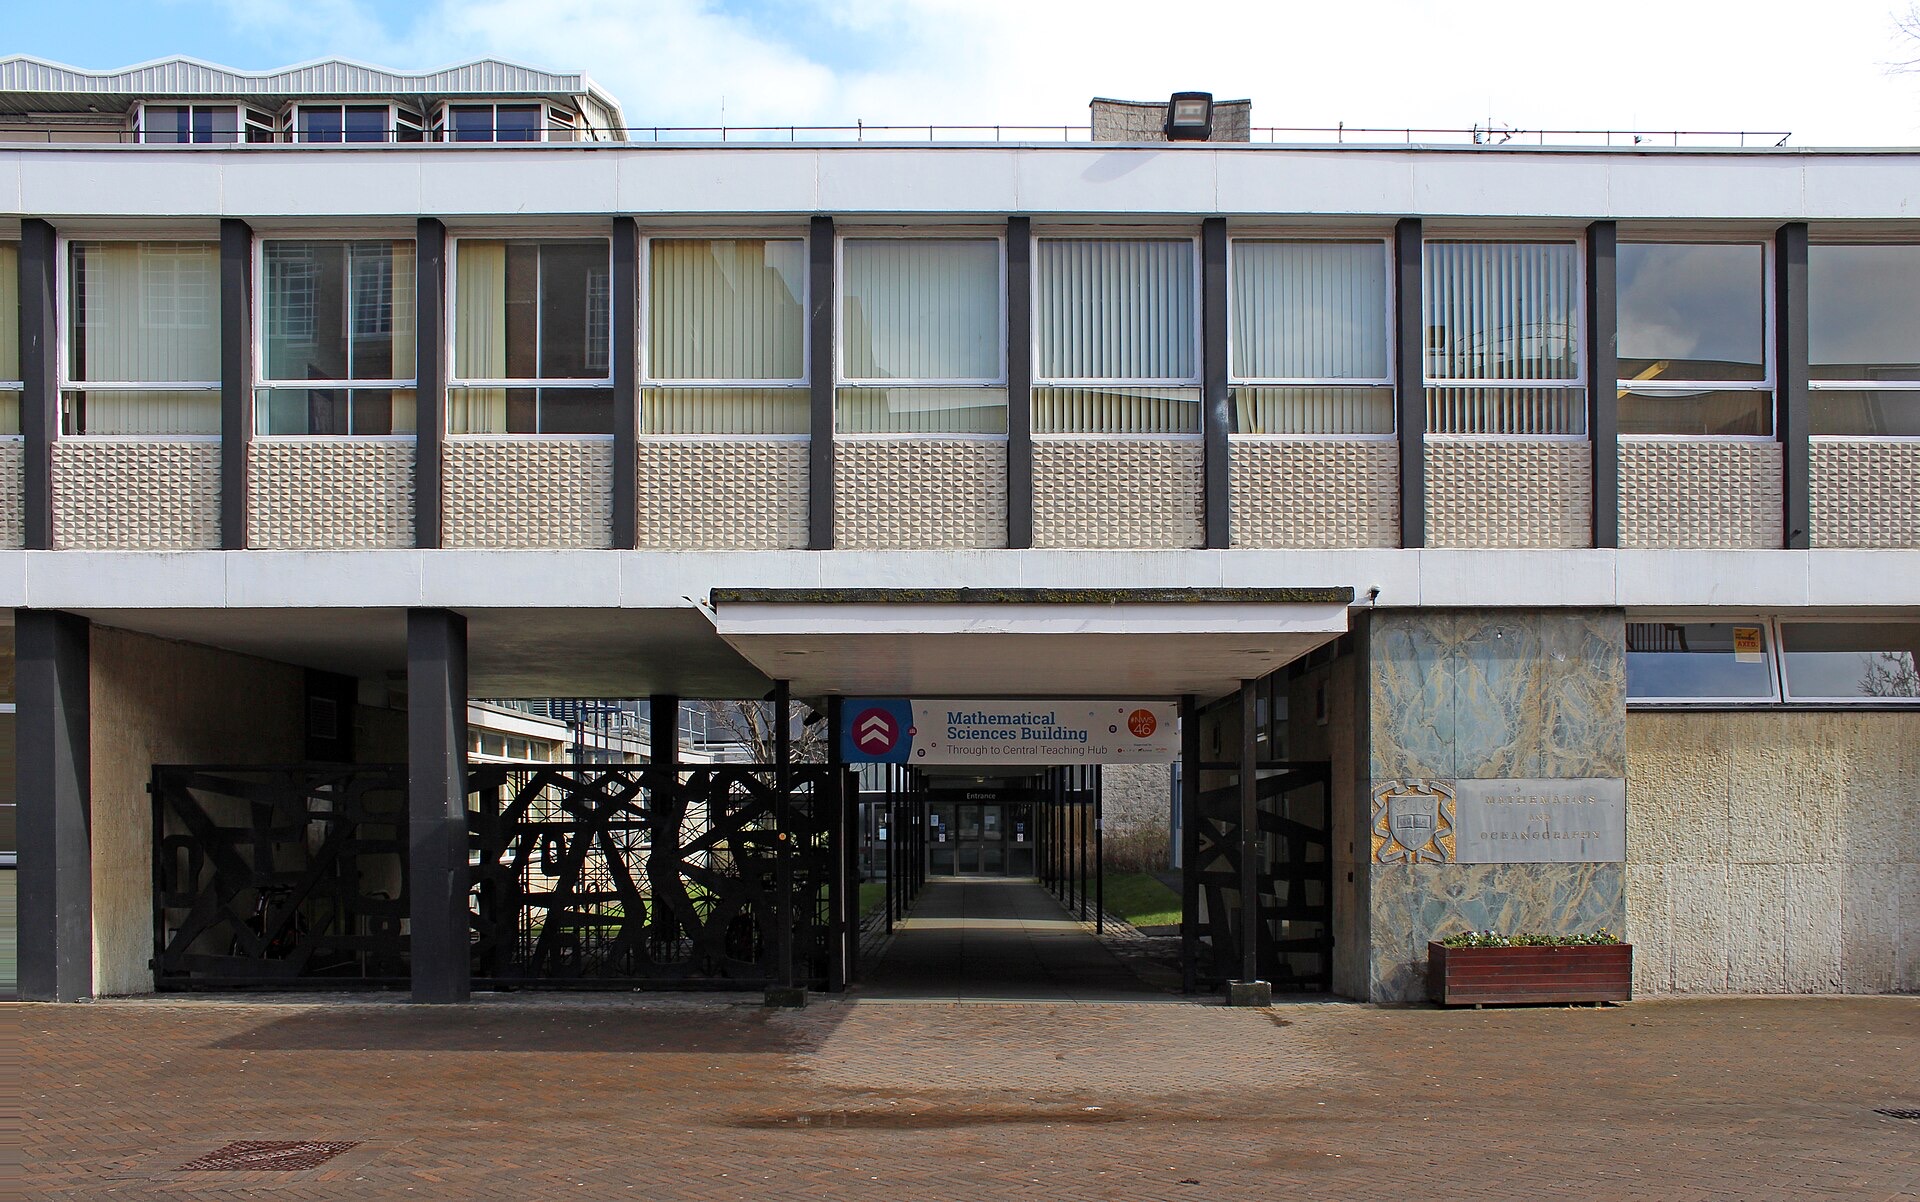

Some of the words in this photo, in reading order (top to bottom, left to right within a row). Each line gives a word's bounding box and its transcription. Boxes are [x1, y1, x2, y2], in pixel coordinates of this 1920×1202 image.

[947, 711, 1056, 725] Mathematical
[947, 726, 1017, 740] Sciences
[1020, 726, 1088, 743] Building
[1133, 723, 1151, 735] 46
[947, 745, 988, 757] Through
[990, 746, 1000, 755] to
[1002, 745, 1037, 755] Central
[1041, 745, 1084, 757] Teaching
[1087, 745, 1108, 755] Hub
[966, 792, 996, 800] Entrance
[1486, 795, 1596, 805] MATHEMATICS
[1528, 813, 1551, 822] AND
[1480, 831, 1601, 841] OCEANOGRAPHY
